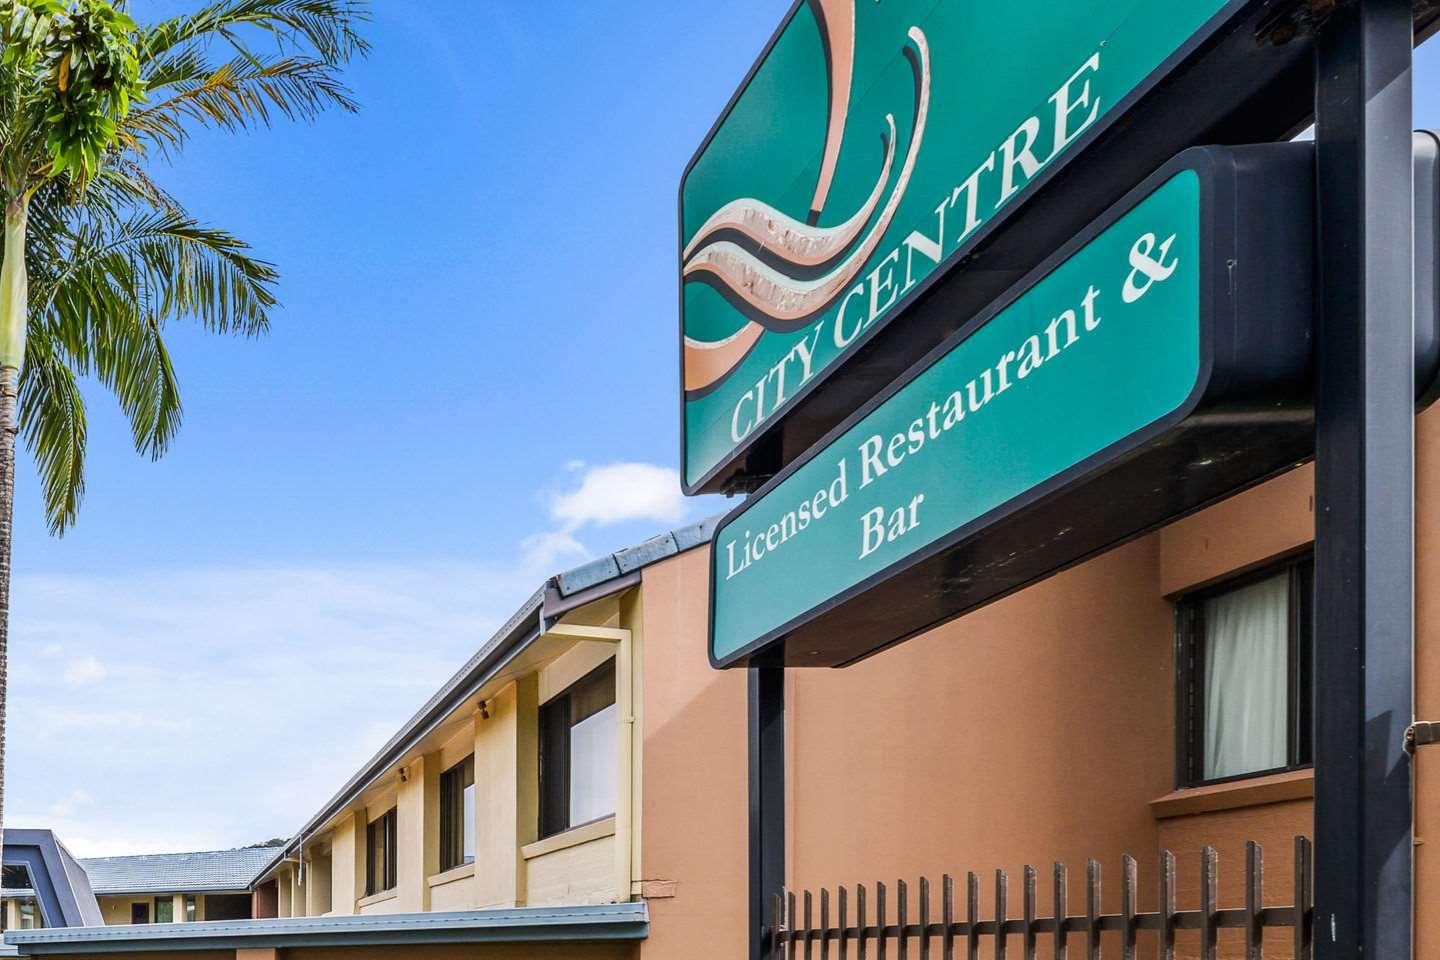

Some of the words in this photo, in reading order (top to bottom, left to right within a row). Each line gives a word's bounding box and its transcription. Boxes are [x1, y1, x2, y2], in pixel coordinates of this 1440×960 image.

[725, 463, 848, 580] Licensed
[859, 284, 1101, 489] Restaurant
[1121, 231, 1178, 304] &
[730, 323, 827, 444] CITY
[832, 52, 1101, 351] CENTRE
[859, 493, 925, 559] Bar
